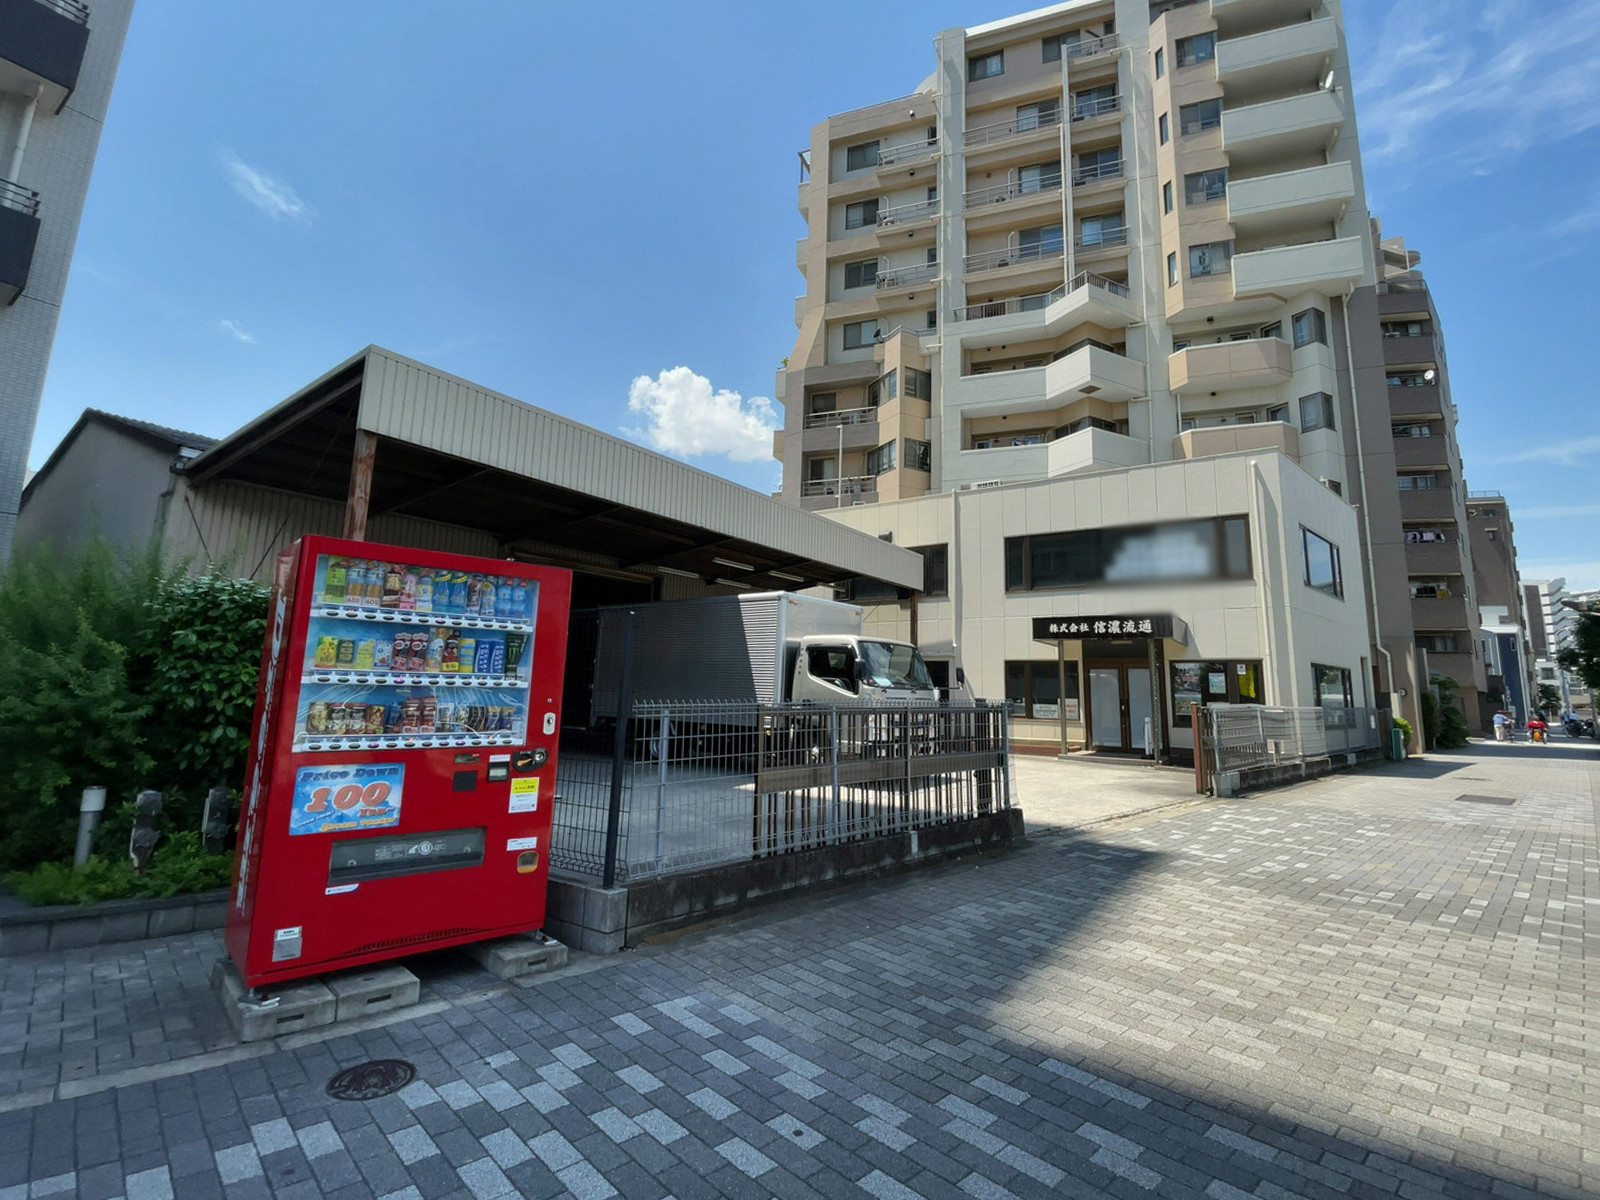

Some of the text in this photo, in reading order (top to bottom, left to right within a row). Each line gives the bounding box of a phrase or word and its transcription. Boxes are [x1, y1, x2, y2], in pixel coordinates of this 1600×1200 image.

[1049, 620, 1152, 633] 株式会社 信濃流通
[300, 767, 399, 782] Price Down
[305, 782, 392, 812] 100
